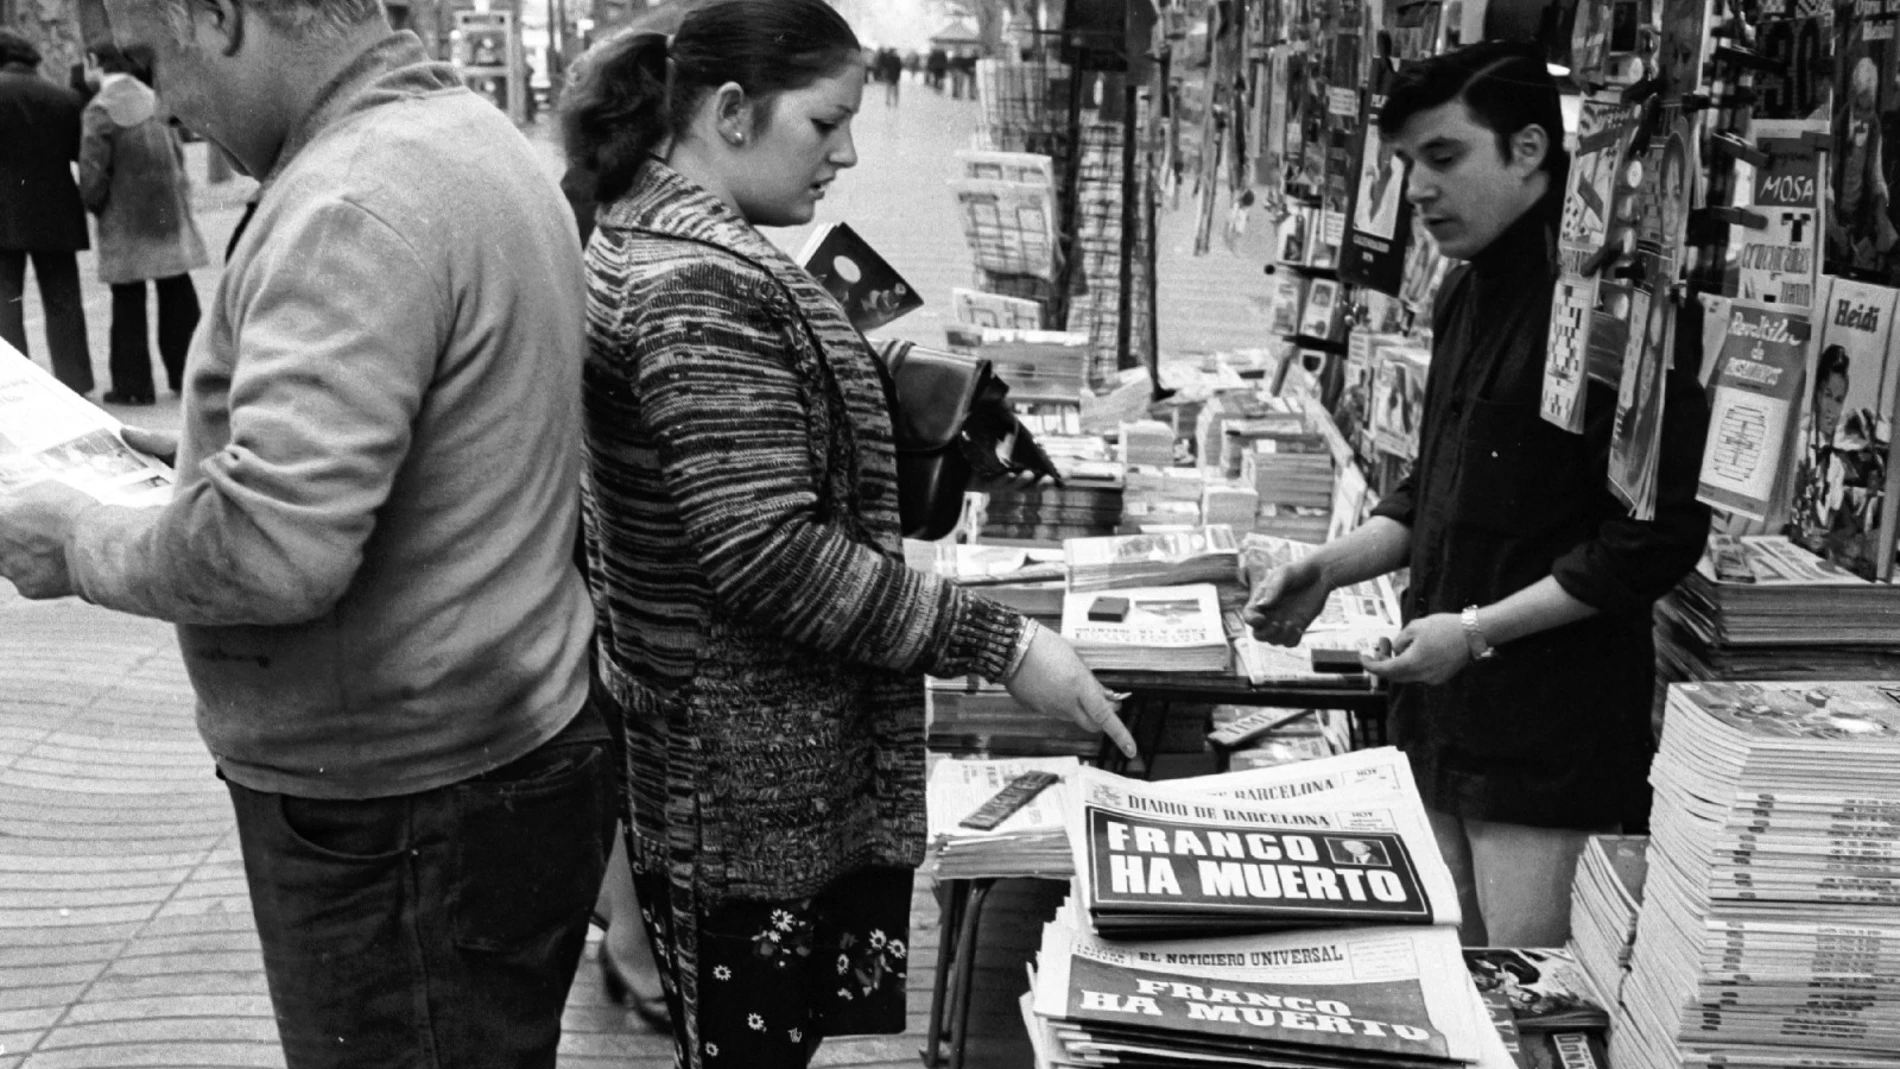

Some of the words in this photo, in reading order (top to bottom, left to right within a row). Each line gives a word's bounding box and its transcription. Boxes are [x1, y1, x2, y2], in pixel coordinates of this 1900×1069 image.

[1759, 175, 1815, 202] MOSA
[1834, 299, 1880, 333] Heidi
[1128, 795, 1188, 816] DIARIO
[1193, 806, 1217, 819] DE
[1222, 809, 1331, 826] BARCELONA
[1106, 821, 1320, 862] FRANCO
[1109, 854, 1183, 896] HA
[1197, 859, 1408, 902] MUERTO
[1139, 952, 1161, 963] EL
[1167, 953, 1246, 966] NOTICIERO
[1250, 945, 1344, 966] UNIVERSAL
[1080, 989, 1163, 1016] HA
[1186, 1001, 1430, 1040] MUERTO
[1136, 978, 1352, 1017] FRANCO
